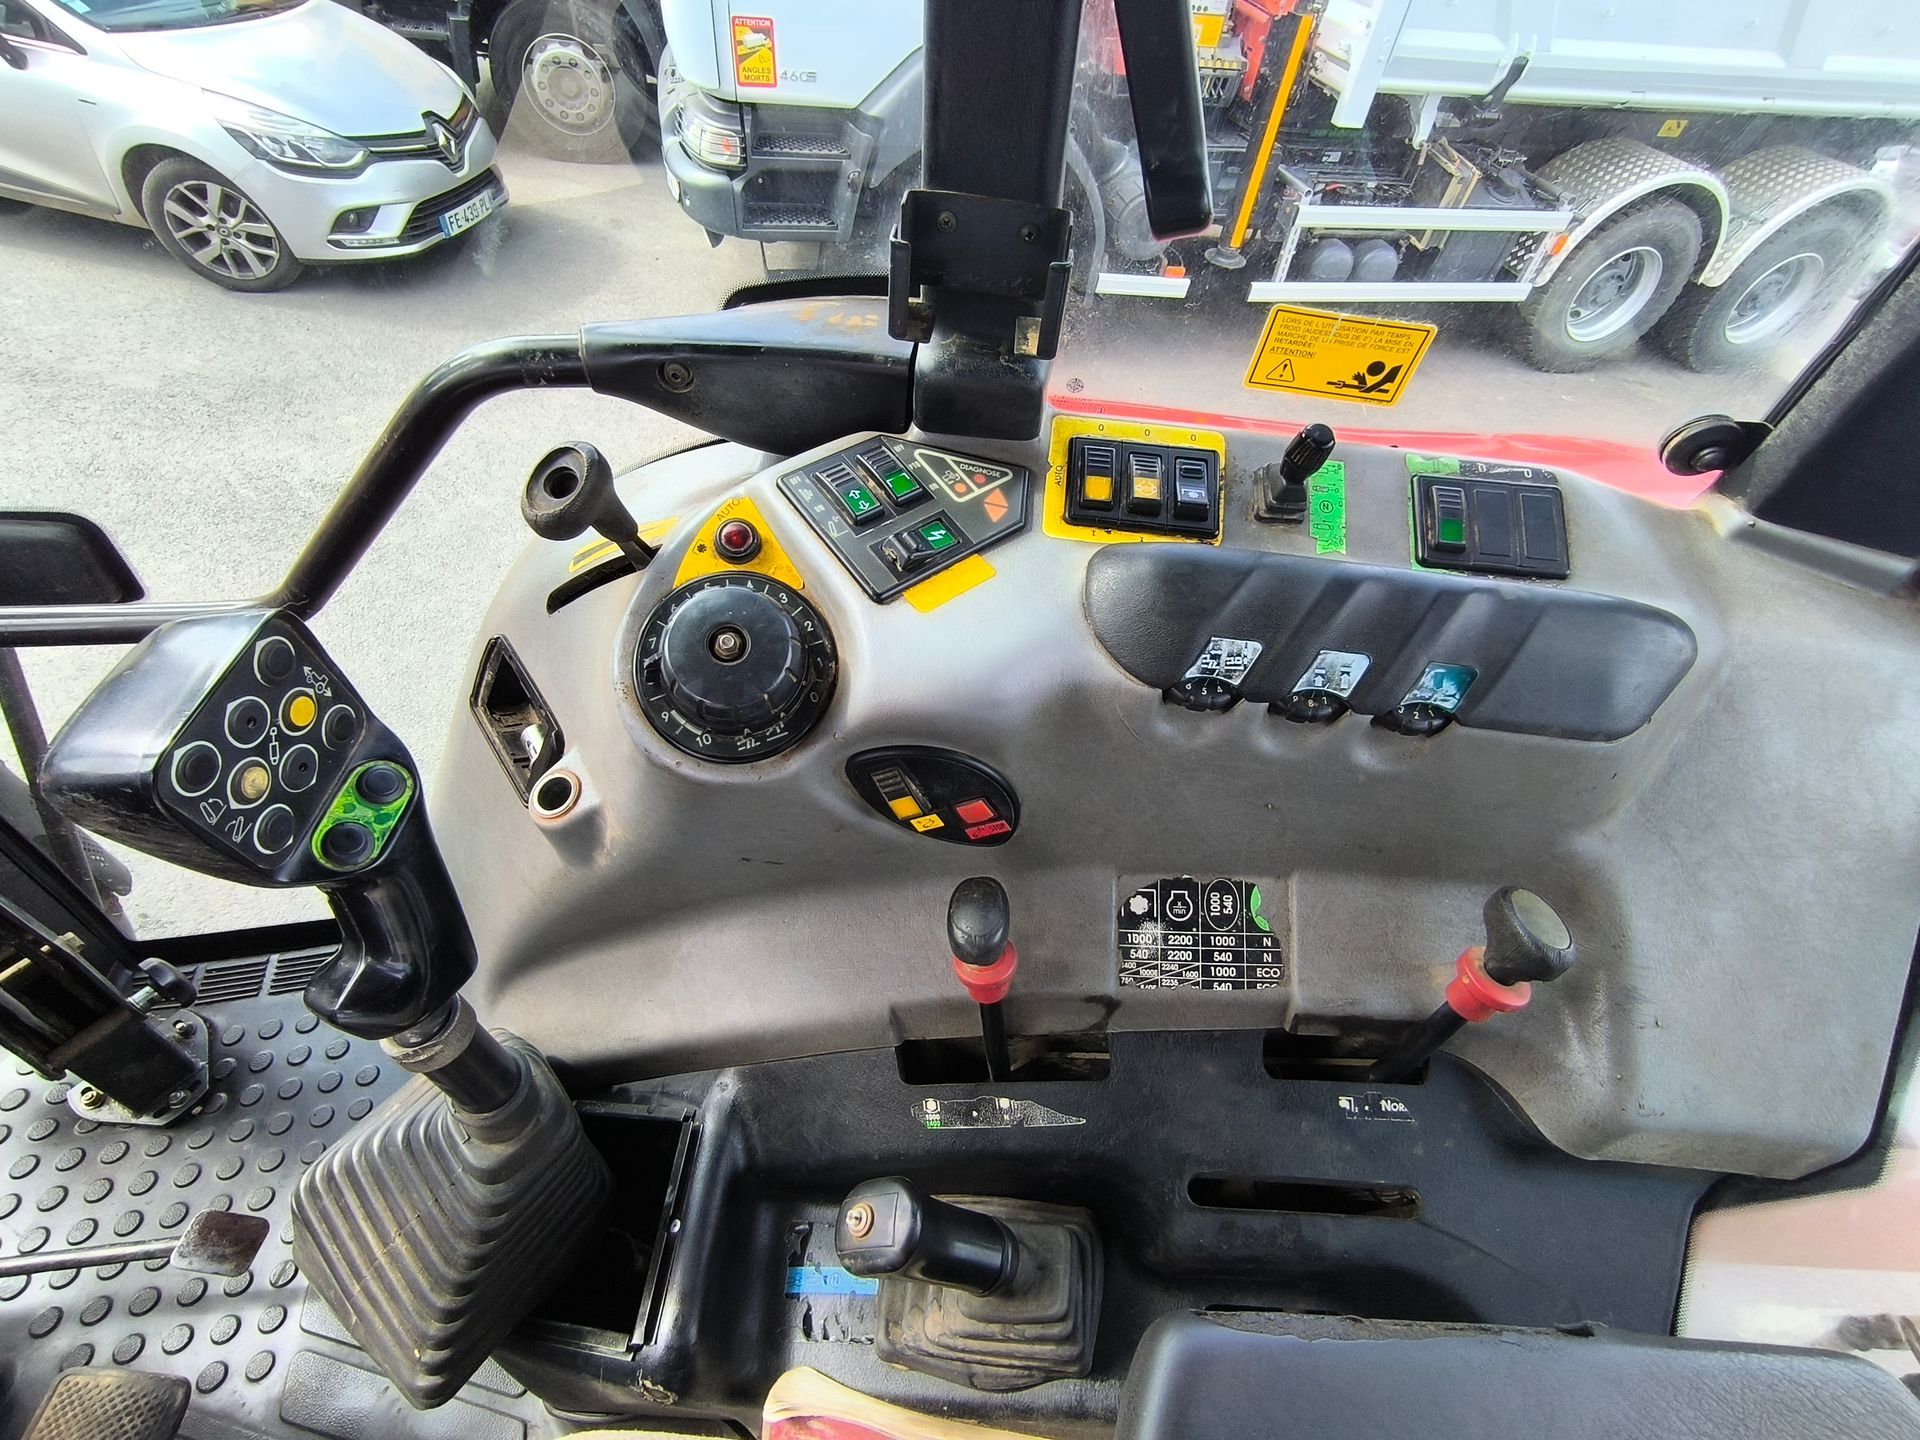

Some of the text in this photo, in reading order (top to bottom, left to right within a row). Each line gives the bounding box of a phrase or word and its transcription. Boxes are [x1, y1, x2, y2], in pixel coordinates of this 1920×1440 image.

[735, 18, 770, 27] ATTENTION
[742, 66, 771, 74] ANGLES
[1282, 316, 1301, 325] LORS
[1387, 331, 1412, 340] TEMPS
[1280, 323, 1301, 332] FROID
[1384, 338, 1402, 346] MISE
[1274, 337, 1316, 349] RETARDÉE!
[1277, 331, 1308, 340] MARCHE
[1334, 338, 1355, 347] PRISE
[1369, 343, 1394, 352] FORCE
[1270, 346, 1317, 358] ATTENTION!
[960, 463, 1000, 478] DIAGNOSE
[1054, 465, 1064, 487] AUTO
[716, 498, 741, 521] AUTO
[779, 593, 788, 603] 3
[804, 621, 814, 631] 2
[649, 637, 656, 649] 7
[817, 657, 823, 667] 1
[810, 692, 819, 702] 0
[1201, 687, 1207, 695] 5
[1308, 699, 1314, 707] 8
[661, 711, 669, 722] 9
[1413, 711, 1420, 719] 2
[696, 733, 712, 748] 10
[989, 820, 1006, 832] STOP
[1210, 892, 1221, 917] 1000
[1223, 894, 1234, 915] 540
[1172, 907, 1186, 915] min
[1127, 934, 1272, 947] 1000 2200 1000 N
[1130, 950, 1272, 962] 540 2200 540 N
[1162, 963, 1178, 971] 2240
[1210, 967, 1236, 977] 1000
[1257, 968, 1280, 978] ECO
[1182, 970, 1199, 978] 1600
[1161, 978, 1178, 986] 2235
[1213, 982, 1233, 990] 540
[1380, 1099, 1409, 1112] NOR
